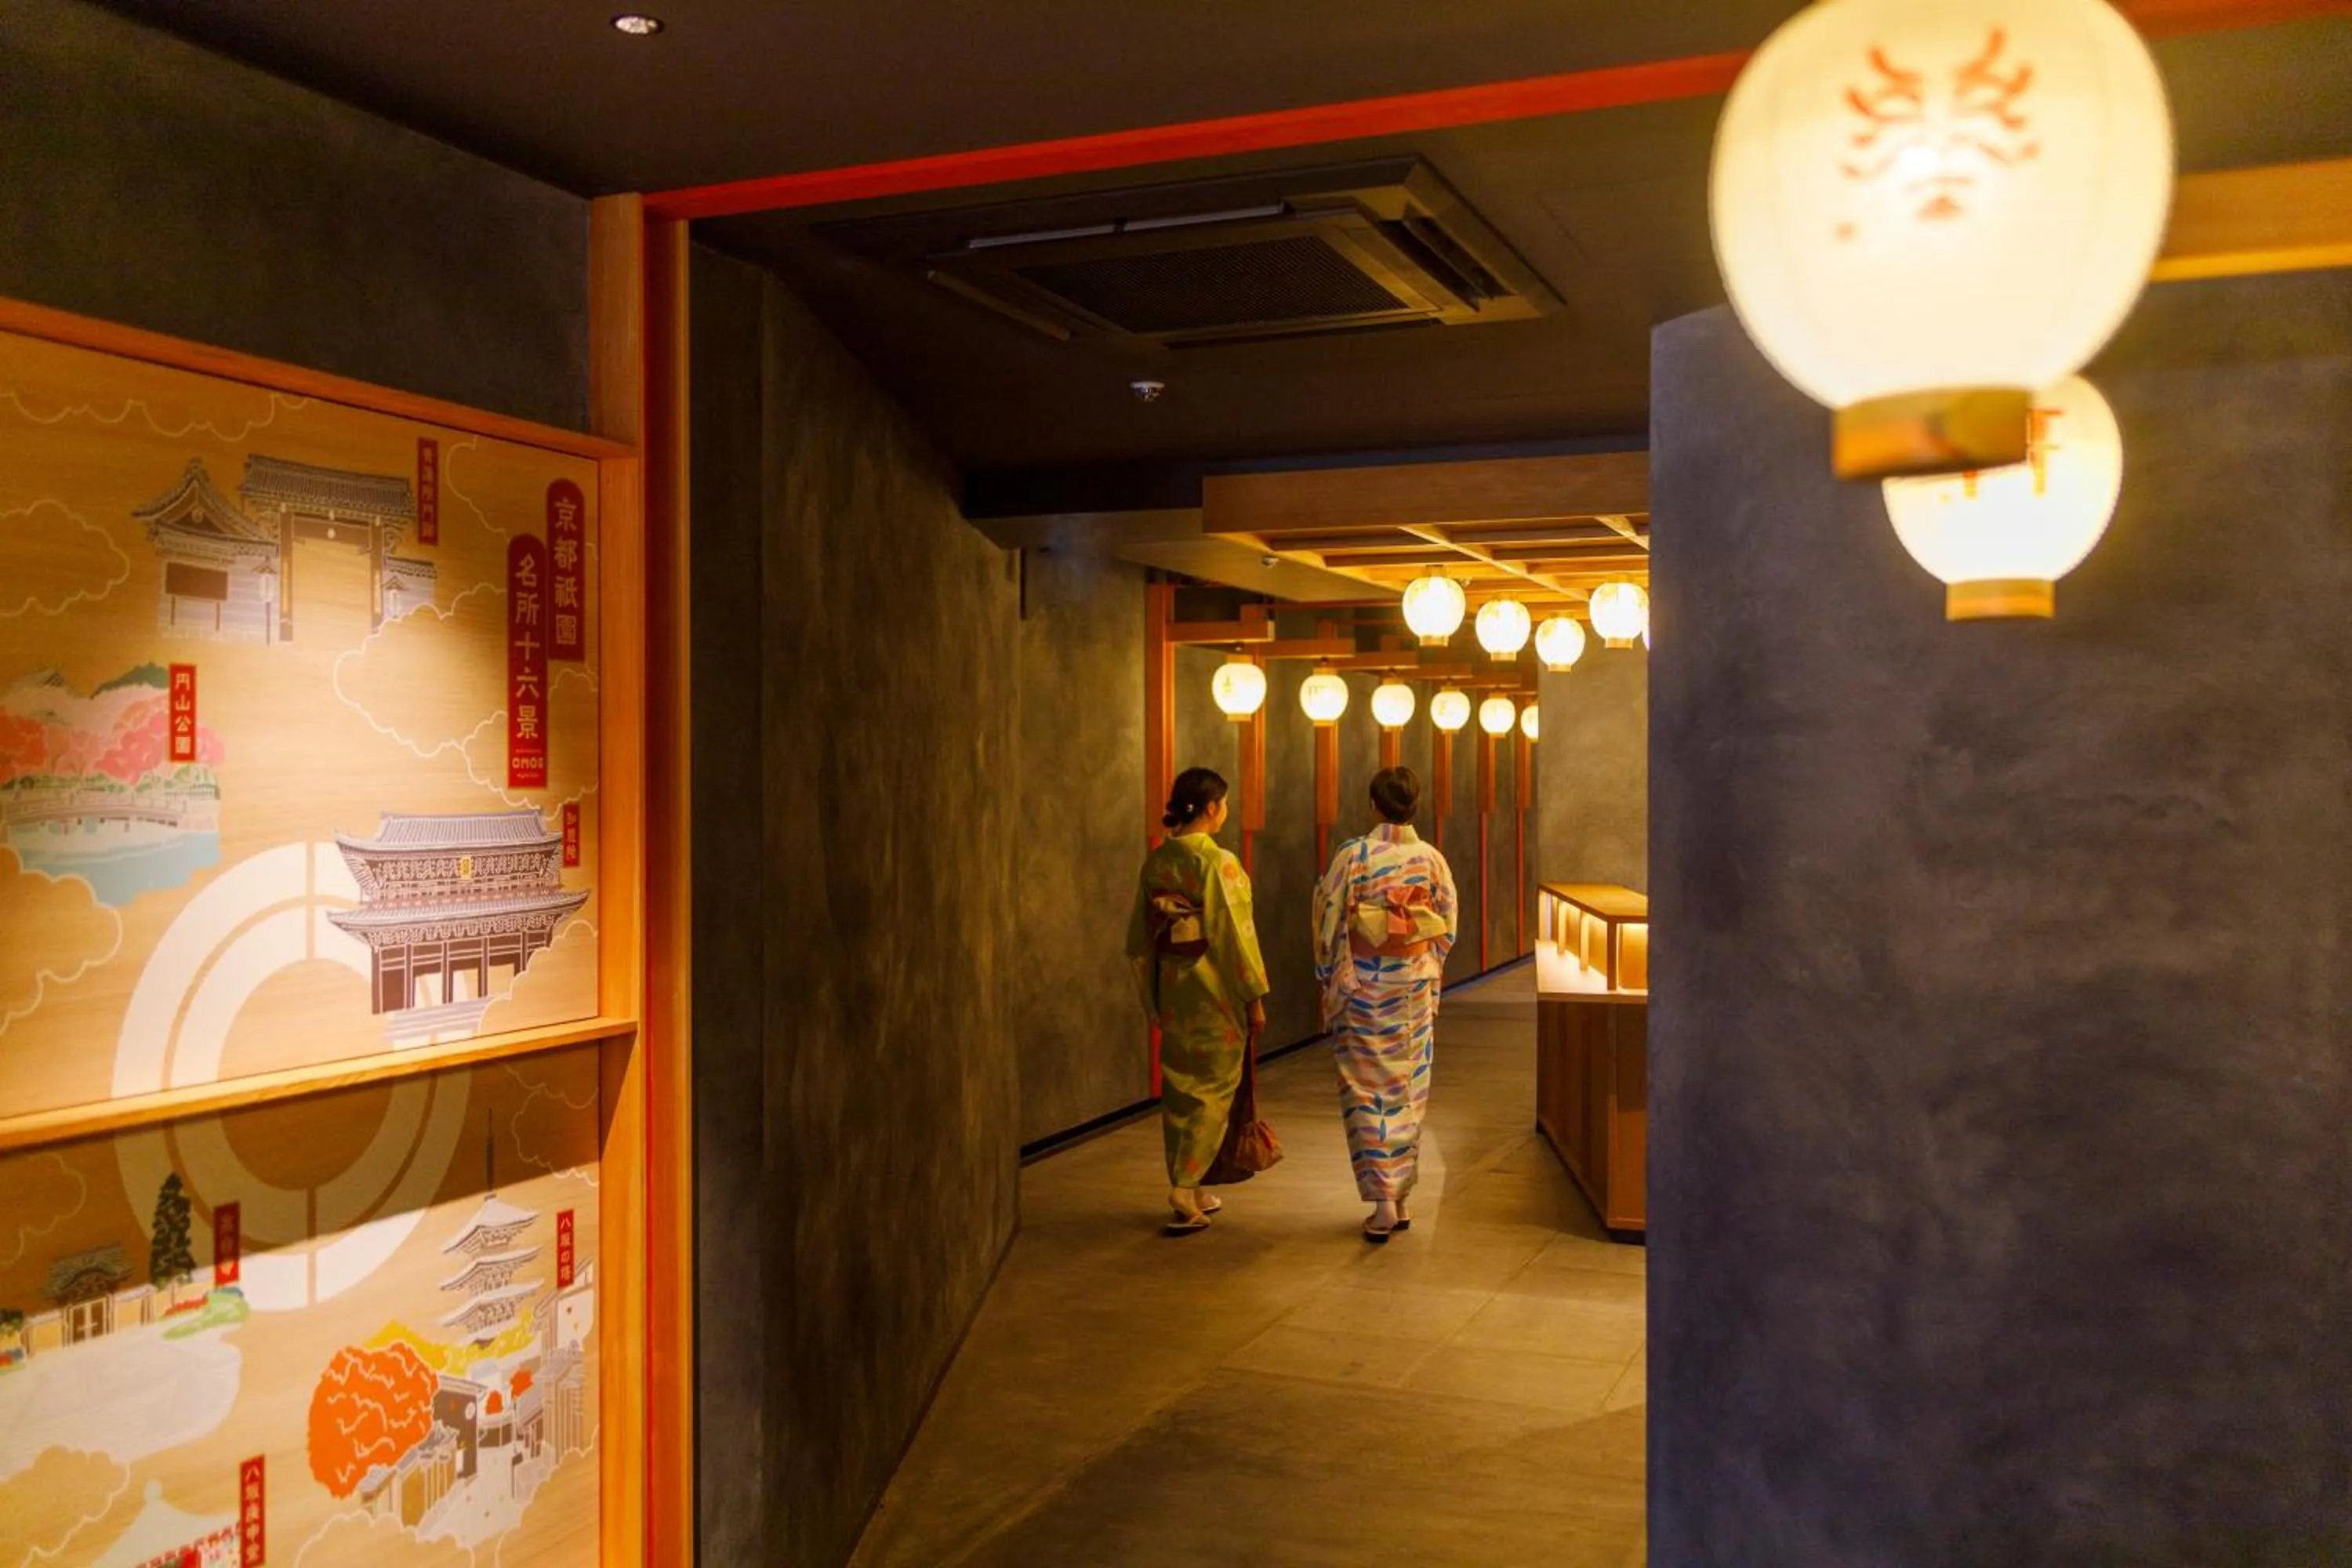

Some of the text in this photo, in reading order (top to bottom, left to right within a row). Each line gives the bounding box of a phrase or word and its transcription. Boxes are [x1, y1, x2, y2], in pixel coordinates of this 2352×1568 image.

[175, 673, 191, 754] 円山公園
[514, 553, 541, 740] 名所十六景
